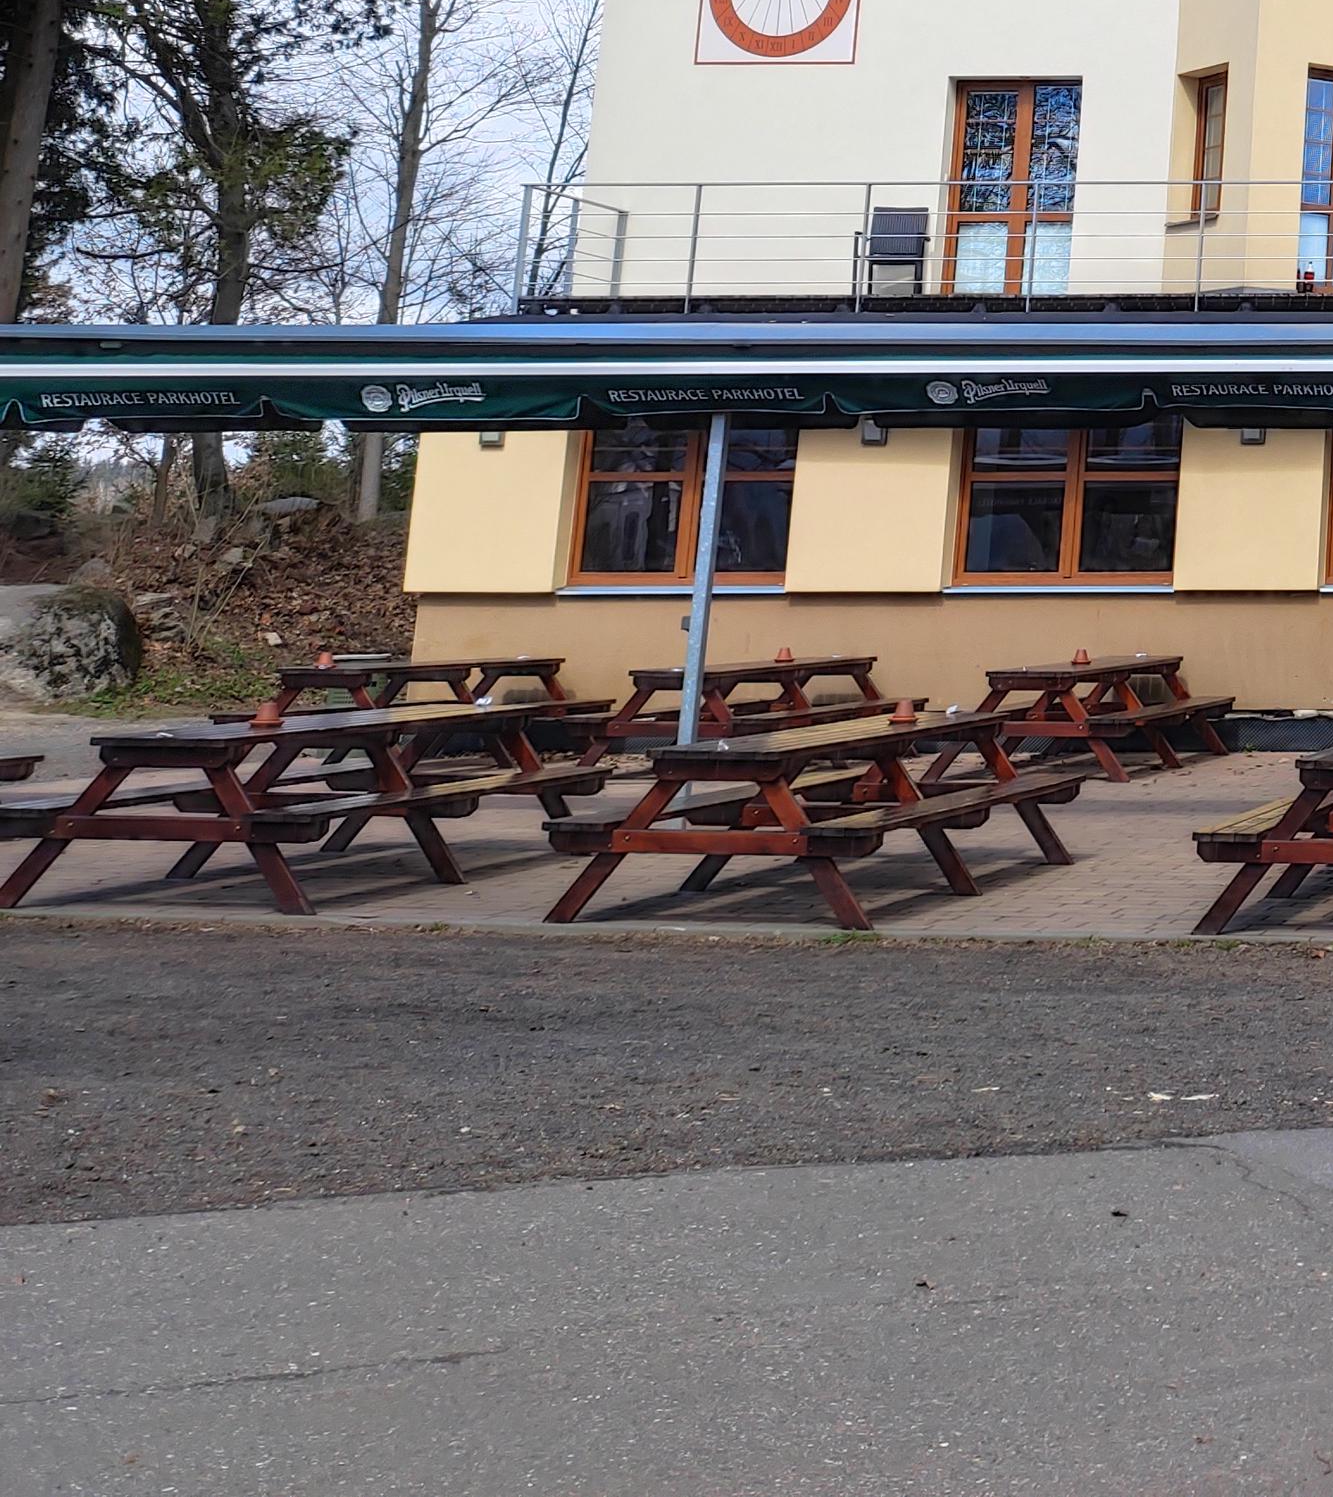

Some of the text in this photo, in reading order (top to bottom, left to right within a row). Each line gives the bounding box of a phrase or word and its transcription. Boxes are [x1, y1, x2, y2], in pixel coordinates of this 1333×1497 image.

[396, 381, 486, 412] Pilsner Urquell
[608, 387, 805, 402] RESTAURACE PARKHOTEL
[961, 378, 1051, 404] Pilsner Urquell
[1171, 384, 1269, 397] RESTAURACE
[40, 391, 240, 408] RESTAURACE PARKHOTEL
